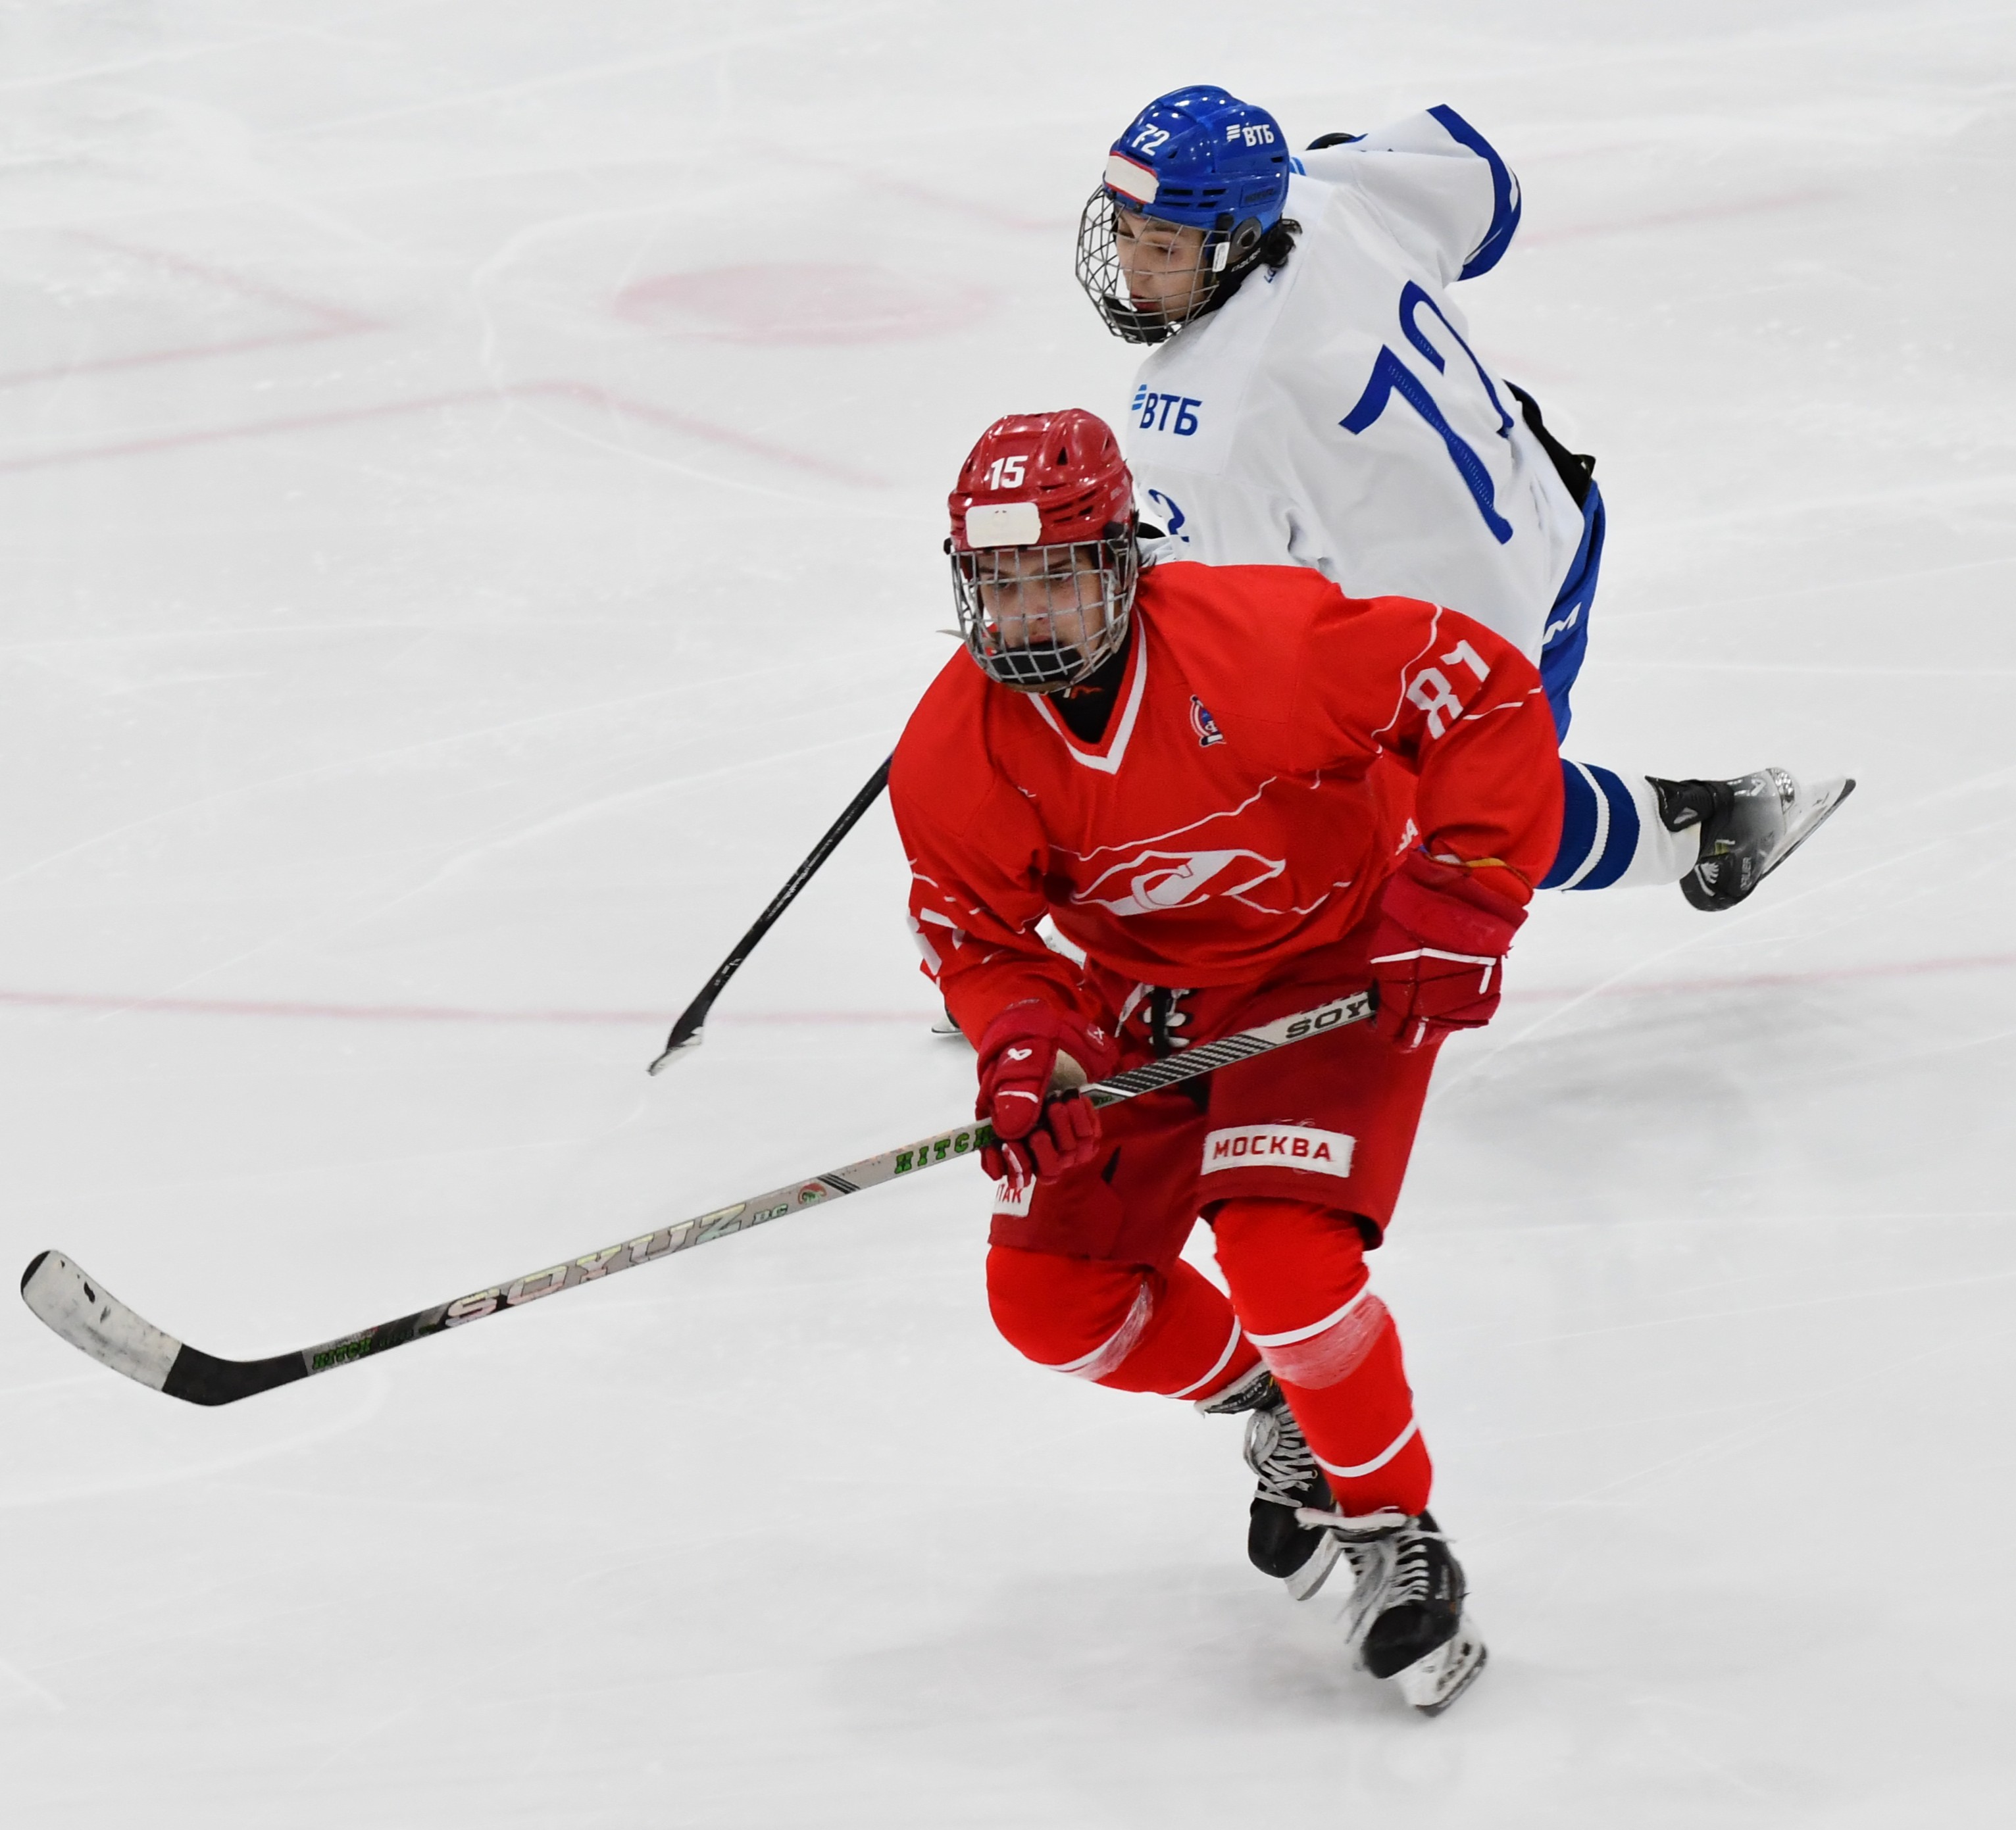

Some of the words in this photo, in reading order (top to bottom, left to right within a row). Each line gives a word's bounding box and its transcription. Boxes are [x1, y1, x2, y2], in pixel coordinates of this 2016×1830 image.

[1131, 123, 1170, 156] 72
[1242, 124, 1274, 147] ВТБ
[1139, 391, 1203, 436] ВТБ
[1338, 280, 1514, 545] 72
[990, 455, 1028, 491] 15
[1212, 1135, 1334, 1162] МОСКВА
[445, 1202, 746, 1328] SOYUZ
